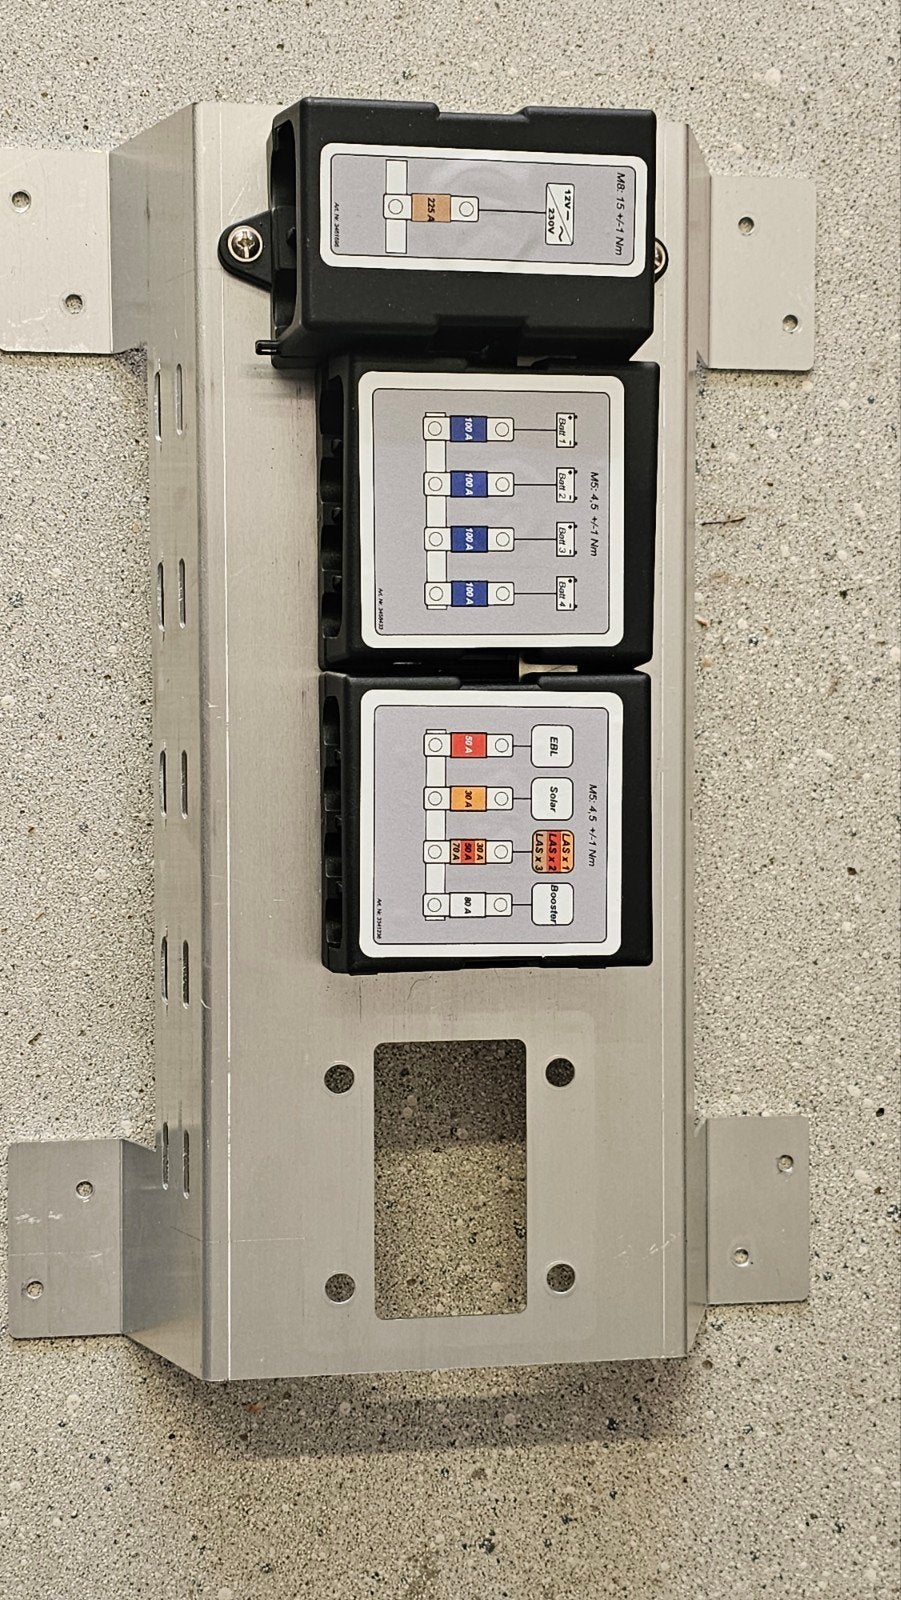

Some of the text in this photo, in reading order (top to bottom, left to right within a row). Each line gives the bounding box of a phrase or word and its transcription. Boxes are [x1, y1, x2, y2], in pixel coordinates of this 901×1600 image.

[427, 197, 436, 214] 225
[614, 172, 626, 256] M8: 15 +/-1 Nm
[547, 208, 555, 235] 230V
[559, 418, 567, 436] Batt
[559, 472, 567, 490] Batt
[590, 472, 599, 491] M5:
[590, 515, 599, 535] +/-1
[559, 526, 567, 544] Batt
[590, 538, 599, 557] Nm
[559, 580, 567, 598] Batt
[465, 735, 473, 746] 50
[549, 736, 558, 757] EBL
[465, 790, 473, 801] 30
[549, 786, 558, 813] Solar
[588, 784, 598, 867] M5: 4,5 +/-1 Nm
[452, 842, 460, 861] 70 A
[464, 842, 472, 861] 50 A
[476, 842, 484, 861] 30 A
[535, 833, 544, 854] LAS
[549, 833, 557, 854] LAS
[562, 833, 571, 854] LAS
[464, 896, 472, 907] 80
[550, 884, 559, 925] Booster
